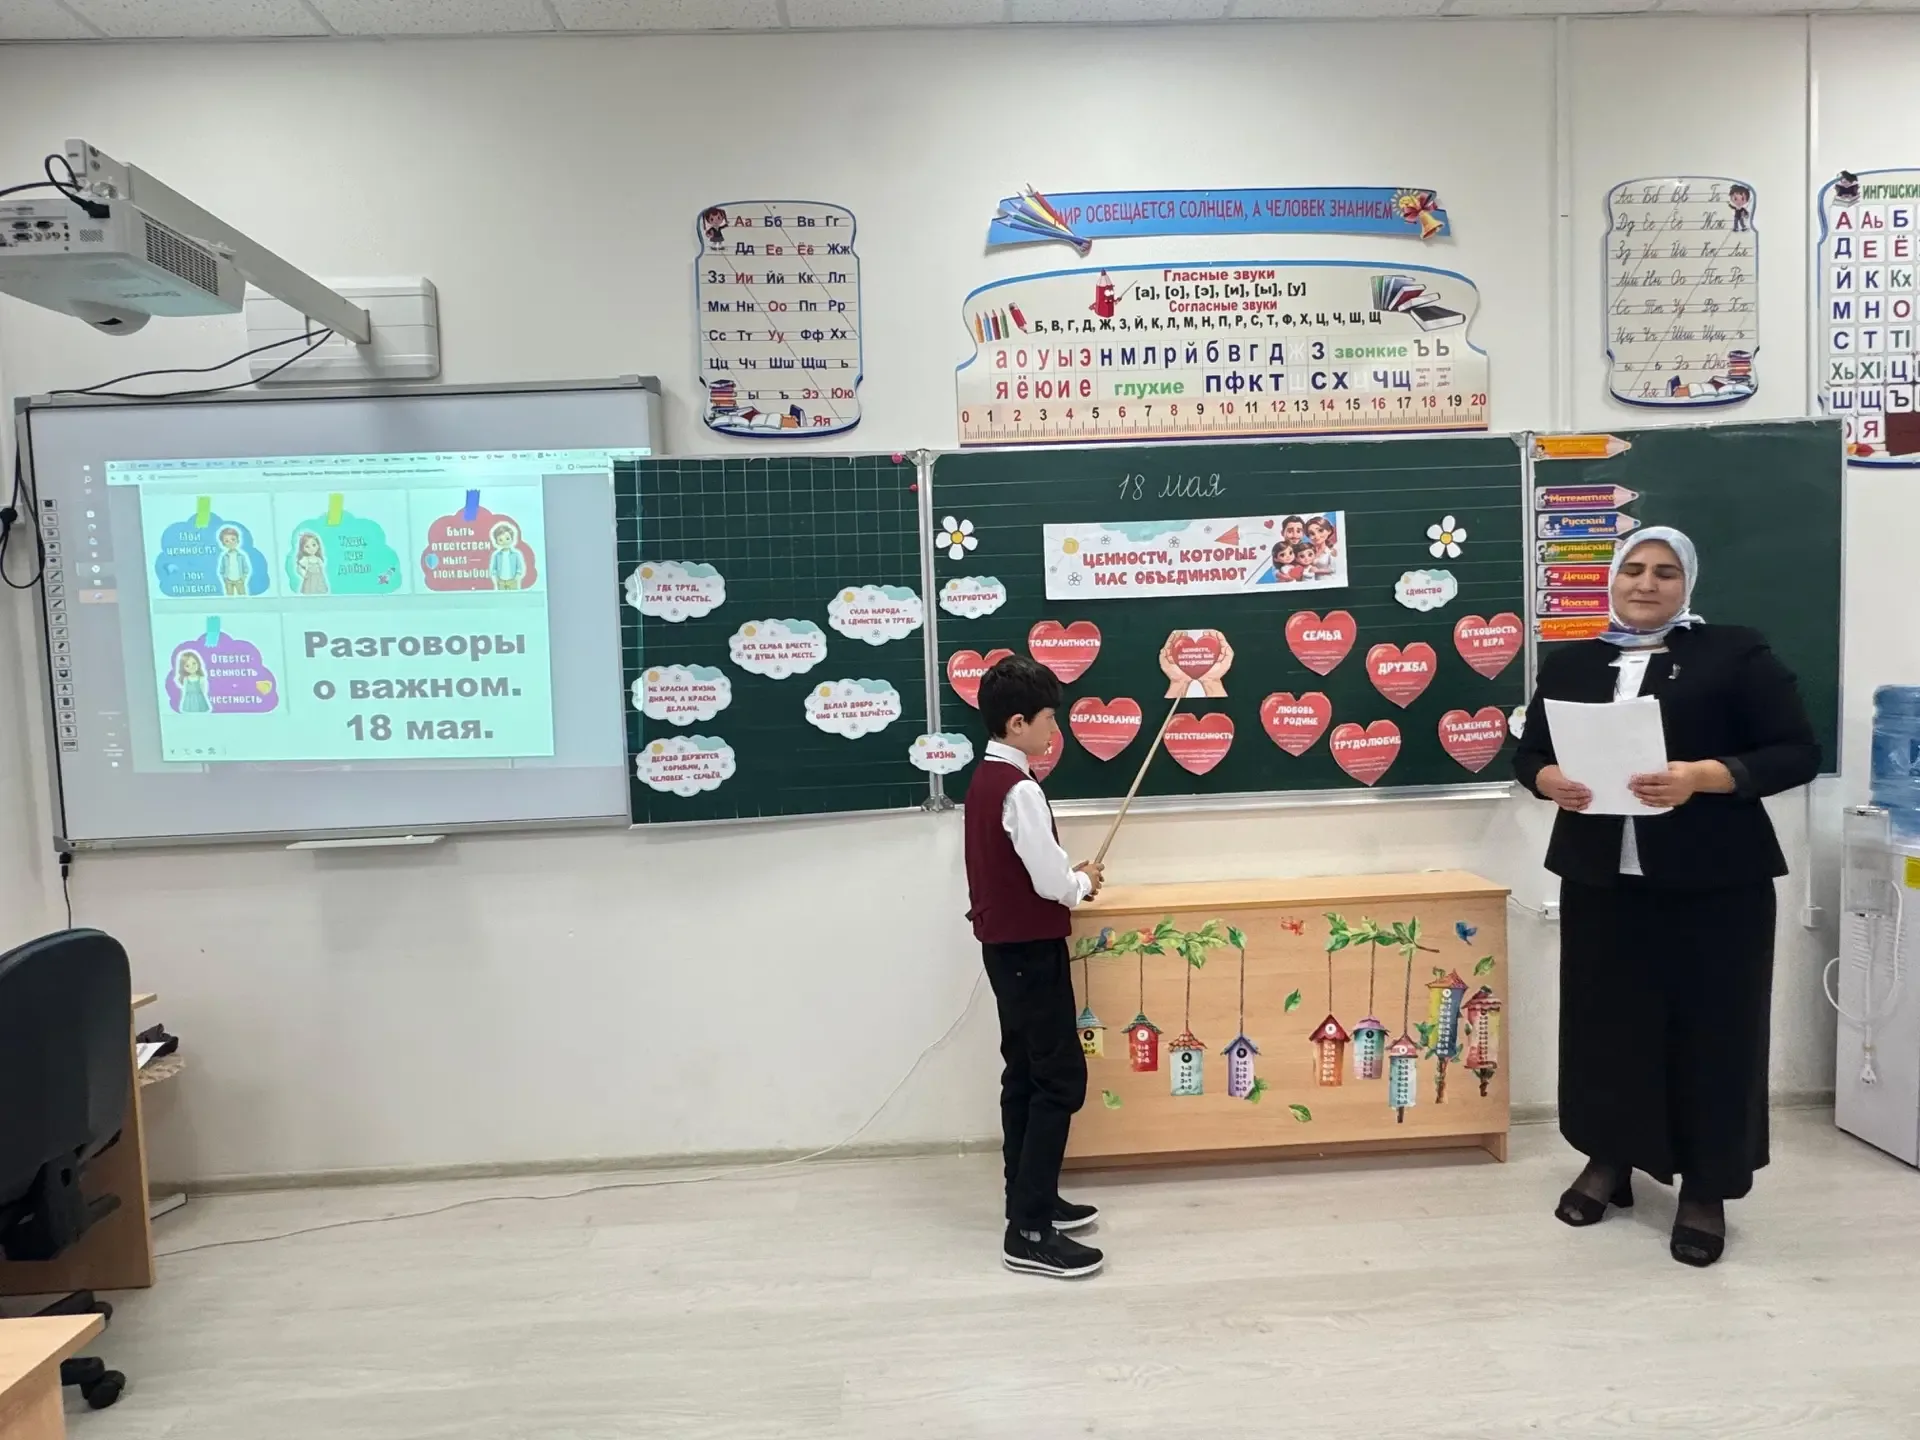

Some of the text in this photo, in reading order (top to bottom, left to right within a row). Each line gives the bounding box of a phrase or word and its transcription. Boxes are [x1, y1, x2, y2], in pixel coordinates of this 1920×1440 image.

[1863, 184, 1920, 200] ИНГУШСКИ
[1086, 200, 1175, 224] ОСВЕЩАЕТСЯ
[1180, 199, 1248, 221] СОЛНЦЕМ,
[1252, 201, 1262, 217] А
[1266, 199, 1325, 217] ЧЕЛОВЕК
[1330, 199, 1393, 219] ЗНАНИЕМ
[735, 216, 839, 227] Аа Бб Вв Гг
[1836, 210, 1909, 229] А Аь Б
[736, 241, 850, 255] Дд Ее Ёё Жж
[1835, 235, 1908, 259] Д Е Ё
[708, 270, 846, 284] Зз Ии Йй Кк Лл
[1164, 270, 1275, 283] Гласные звуки
[1836, 265, 1911, 289] Й К Кх
[1136, 286, 1160, 300] [а],
[1288, 282, 1306, 296] [у]
[708, 300, 846, 312] Мм Нн Оо Пп Рр
[1169, 300, 1277, 313] Согласные звуки
[1833, 300, 1910, 319] М Н О
[1335, 345, 1408, 359] звонкие
[1114, 380, 1184, 399] глухие
[1220, 394, 1486, 414] 10 11 12 13 14 15 16 17 18 19 20
[1118, 473, 1227, 500] 18 мая
[1562, 516, 1605, 527] Русский
[1082, 547, 1257, 569] ЦЕННОСТИ, КОТОРЫЕ
[1095, 567, 1247, 585] НАС ОБЪЕДИНЯЮТ
[947, 593, 998, 602] ПАТРИОТИЗМ
[1303, 630, 1342, 642] СЕМЬЯ
[1461, 626, 1517, 639] ДУХОВНОСТЬ
[304, 631, 526, 662] Разговоры
[1030, 638, 1100, 647] ТОЛЕРАНТНОСТЬ
[1483, 638, 1504, 646] ВЕРА
[1378, 662, 1428, 675] ДРУЖБА
[313, 676, 522, 700] о важном.
[1276, 705, 1314, 715] ЛЮБОВЬ
[1070, 714, 1141, 725] ОБРАЗОВАНИЕ
[1284, 717, 1318, 726] РОДИНЕ
[347, 714, 494, 741] 18 мая.
[926, 751, 956, 759] ЖИЗНЬ
